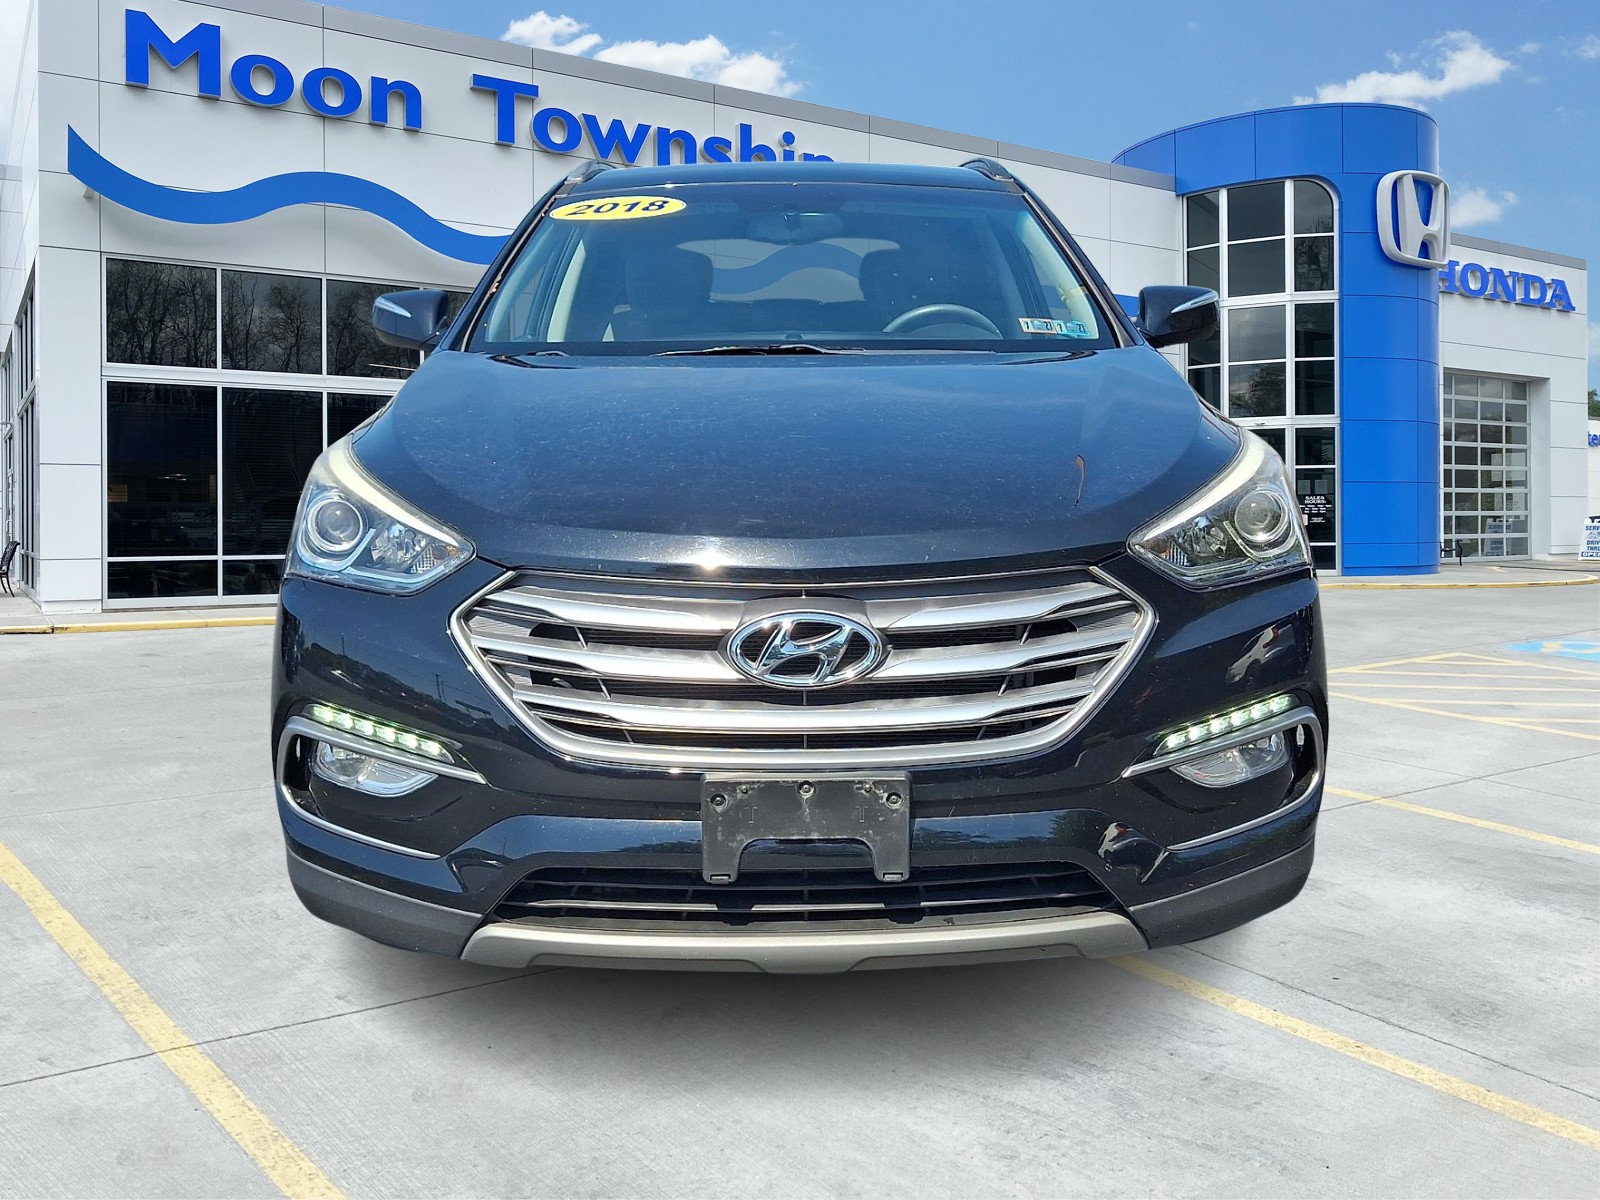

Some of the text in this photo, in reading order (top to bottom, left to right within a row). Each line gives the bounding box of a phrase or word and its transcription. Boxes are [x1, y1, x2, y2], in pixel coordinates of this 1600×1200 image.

[125, 9, 836, 166] Moon Townshi
[566, 200, 669, 216] 2018
